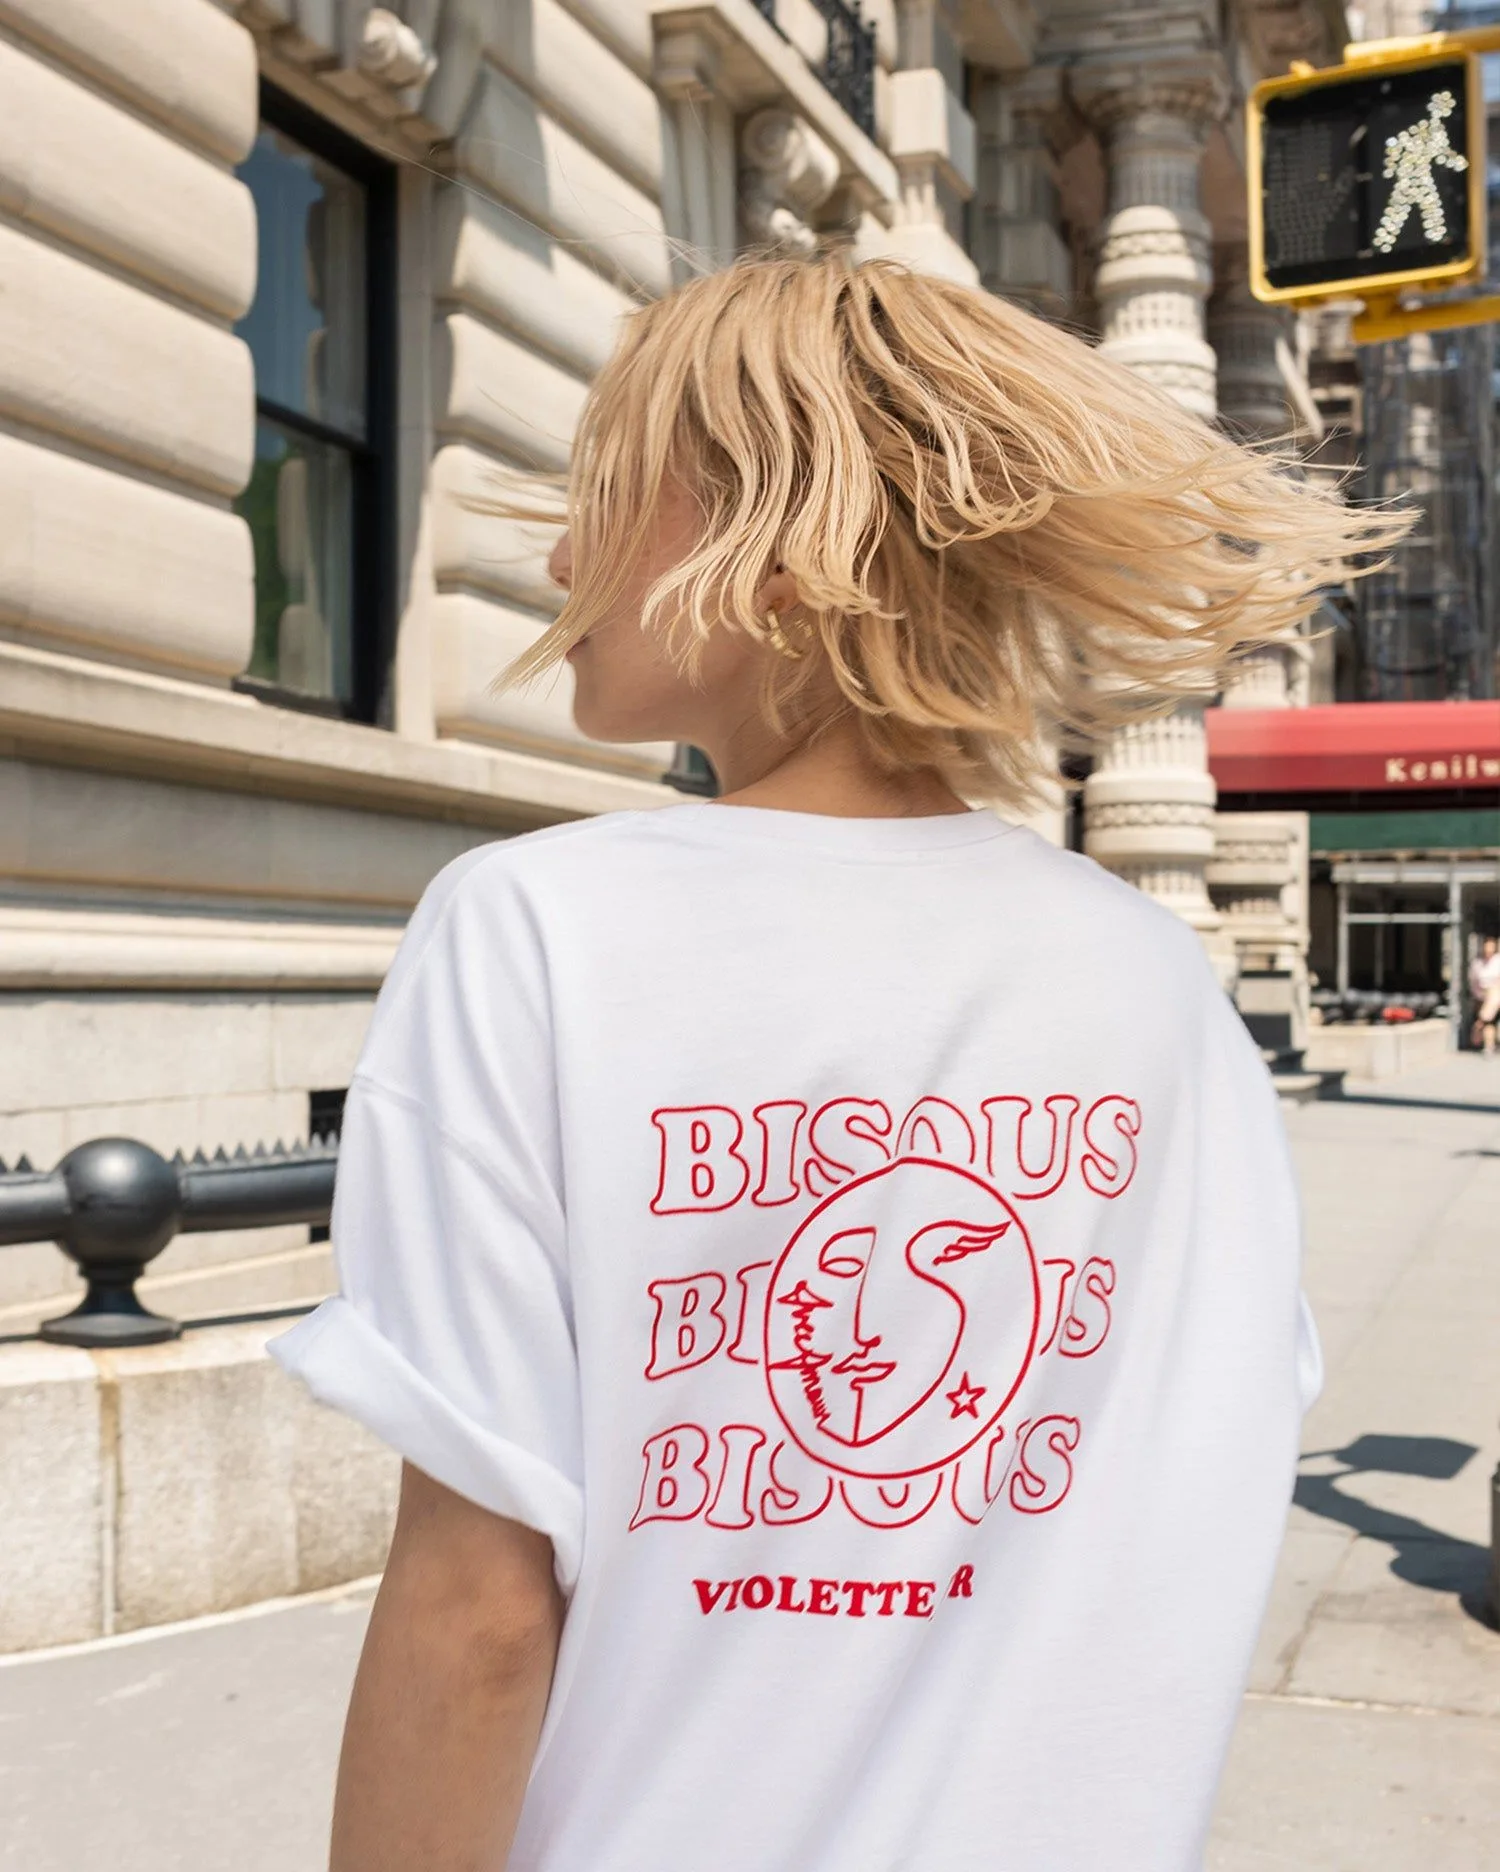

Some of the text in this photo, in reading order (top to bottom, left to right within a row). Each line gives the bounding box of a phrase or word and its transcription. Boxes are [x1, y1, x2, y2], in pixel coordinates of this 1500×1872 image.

[650, 1094, 1142, 1216] BISOUS
[644, 1256, 1116, 1382] BIS
[692, 1574, 937, 1619] VIOLETTE
